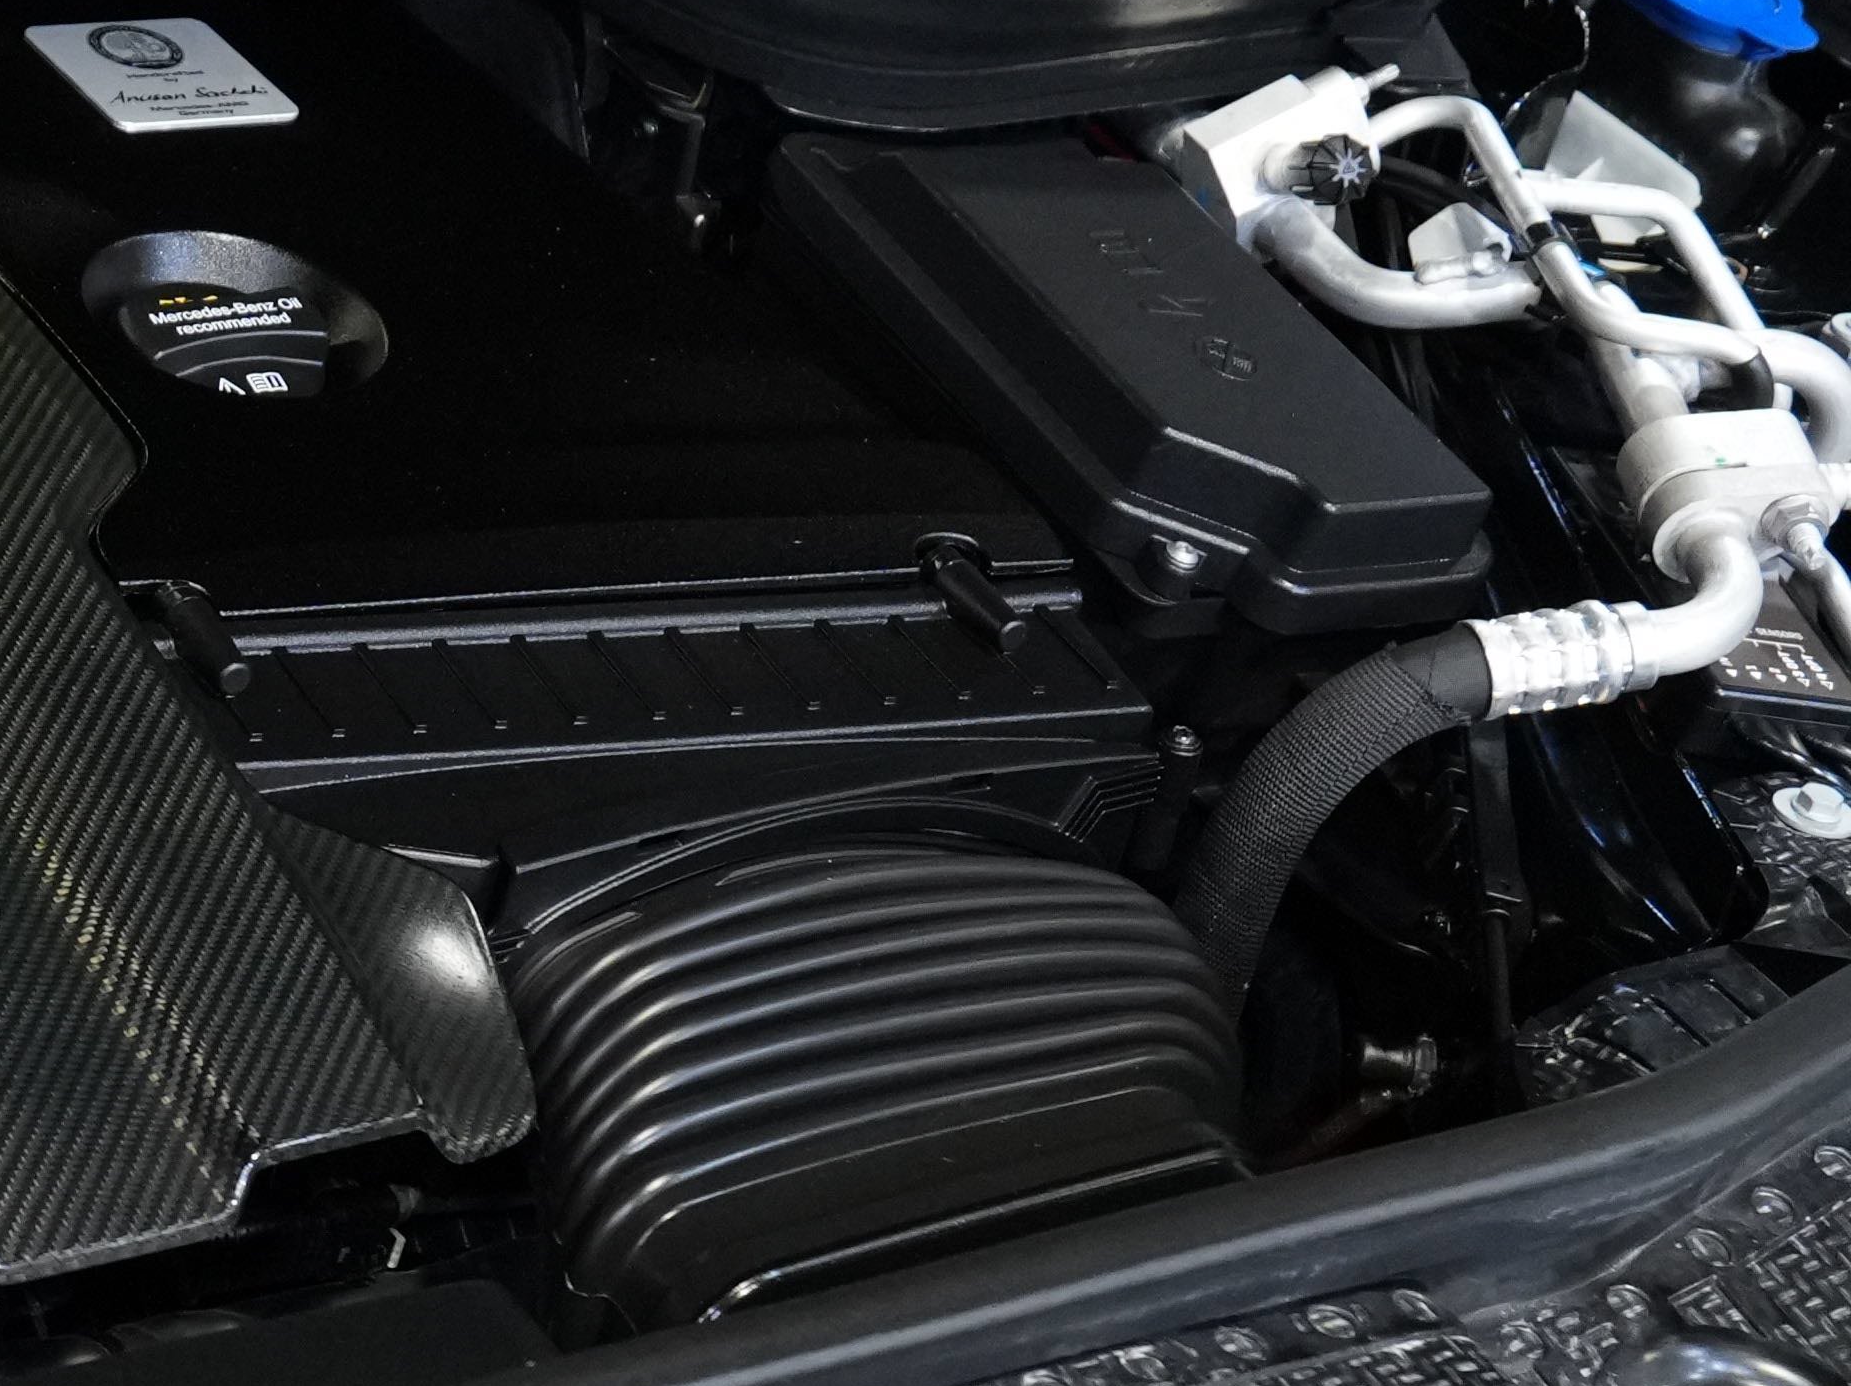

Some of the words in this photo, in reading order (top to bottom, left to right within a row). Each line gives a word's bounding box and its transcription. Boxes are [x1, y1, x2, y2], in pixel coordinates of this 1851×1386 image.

[148, 300, 278, 325] Mercedes-Benz
[277, 296, 303, 311] Oil
[175, 312, 292, 336] recommended
